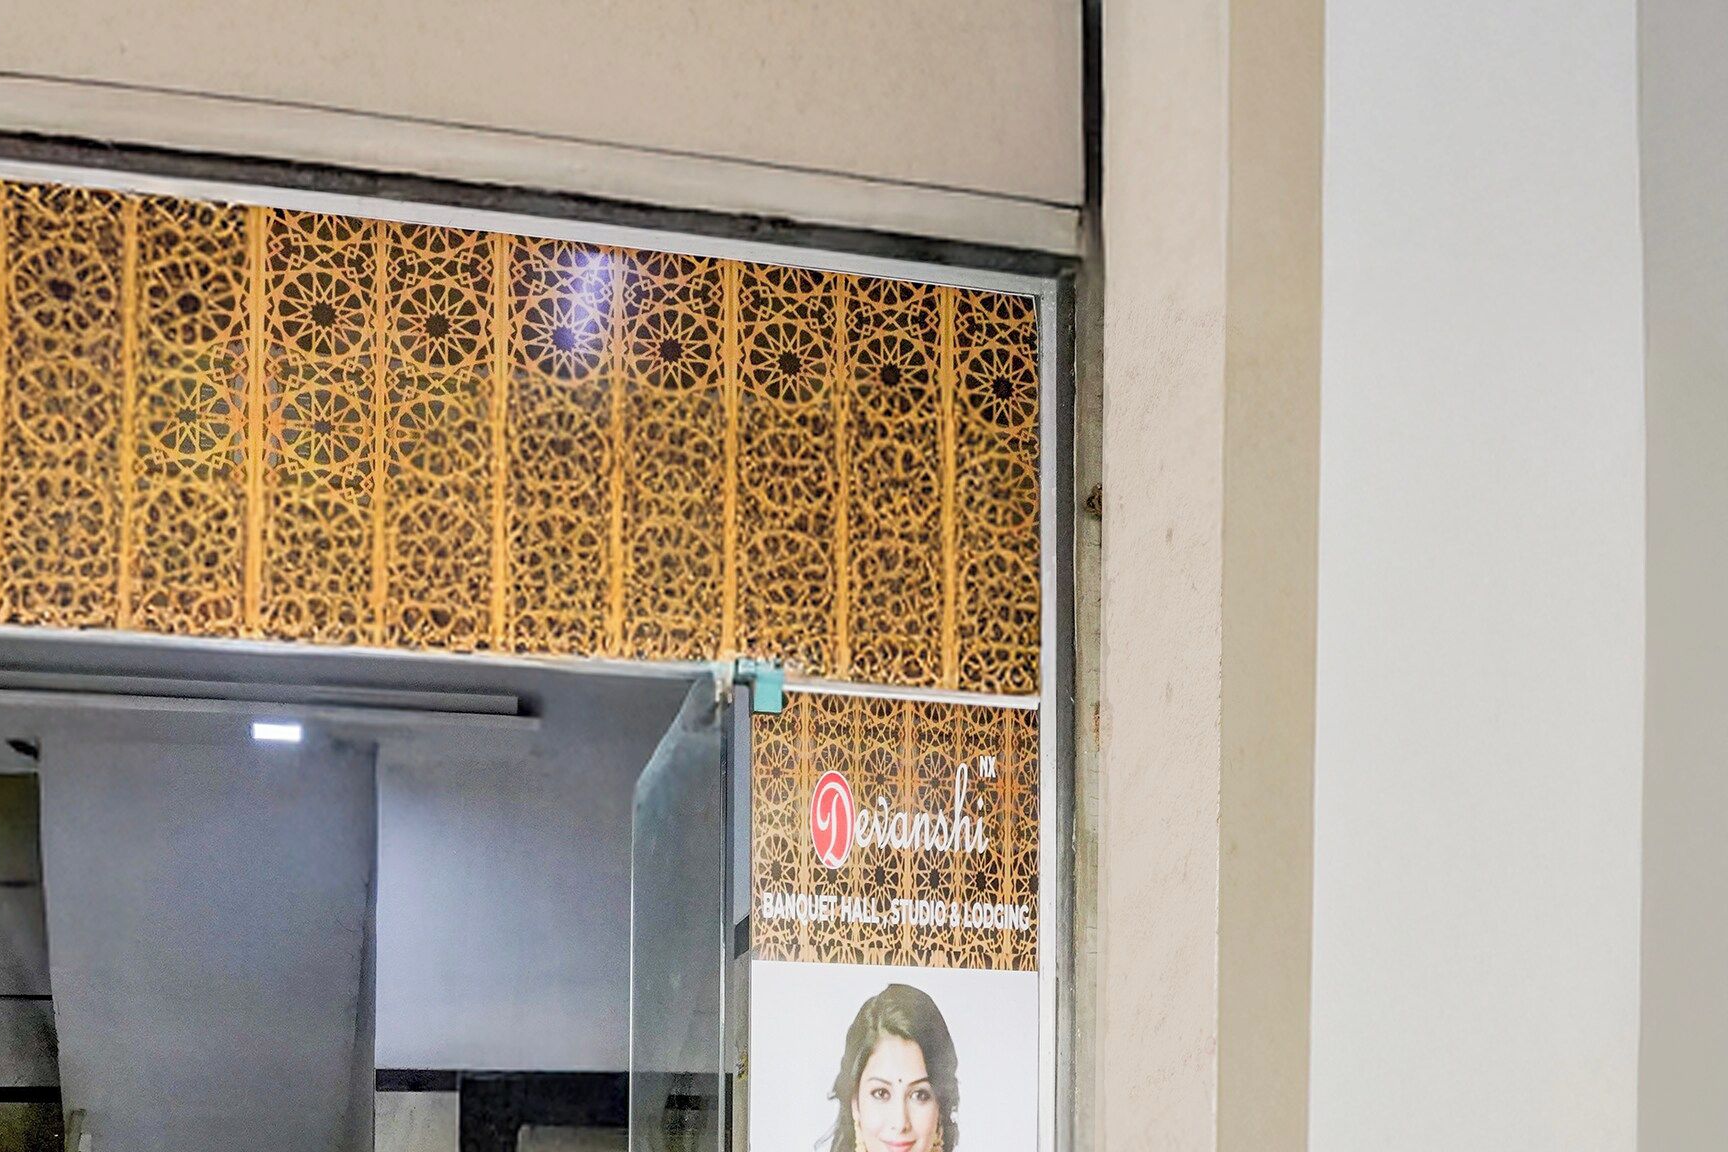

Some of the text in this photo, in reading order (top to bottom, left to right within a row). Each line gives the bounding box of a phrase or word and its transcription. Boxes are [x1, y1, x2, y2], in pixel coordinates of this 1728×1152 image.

[813, 756, 996, 867] Devanshi NX
[762, 893, 838, 926] BANQUET
[890, 899, 946, 927] STUDIO
[950, 907, 960, 928] &
[963, 904, 1030, 931] LODGING
